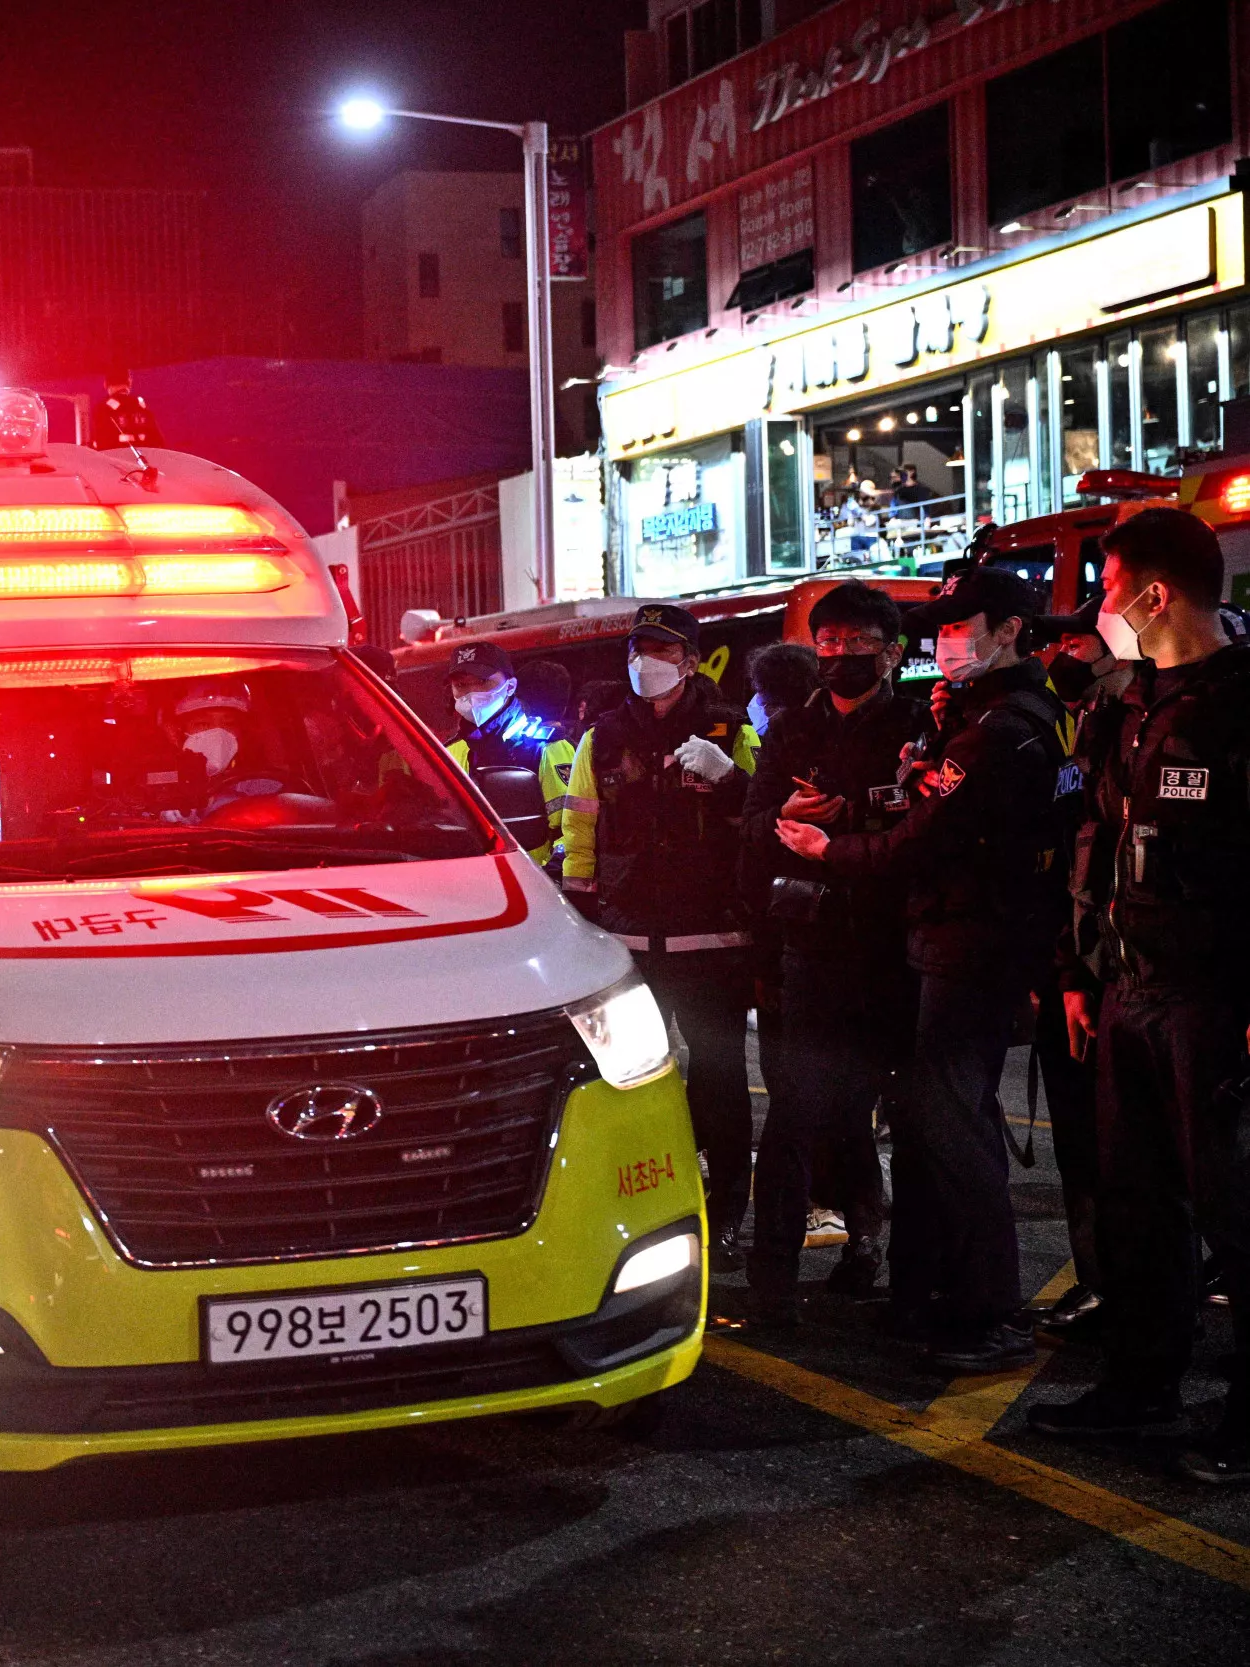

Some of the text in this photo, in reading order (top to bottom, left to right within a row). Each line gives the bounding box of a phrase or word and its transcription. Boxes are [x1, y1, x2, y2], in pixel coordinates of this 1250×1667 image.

[558, 614, 635, 640] SPECIAL RESCU
[1166, 771, 1203, 786] 경찰
[1162, 787, 1203, 798] POLICE
[617, 1153, 675, 1197] 서초6-4
[226, 1290, 468, 1354] 998보 2503
